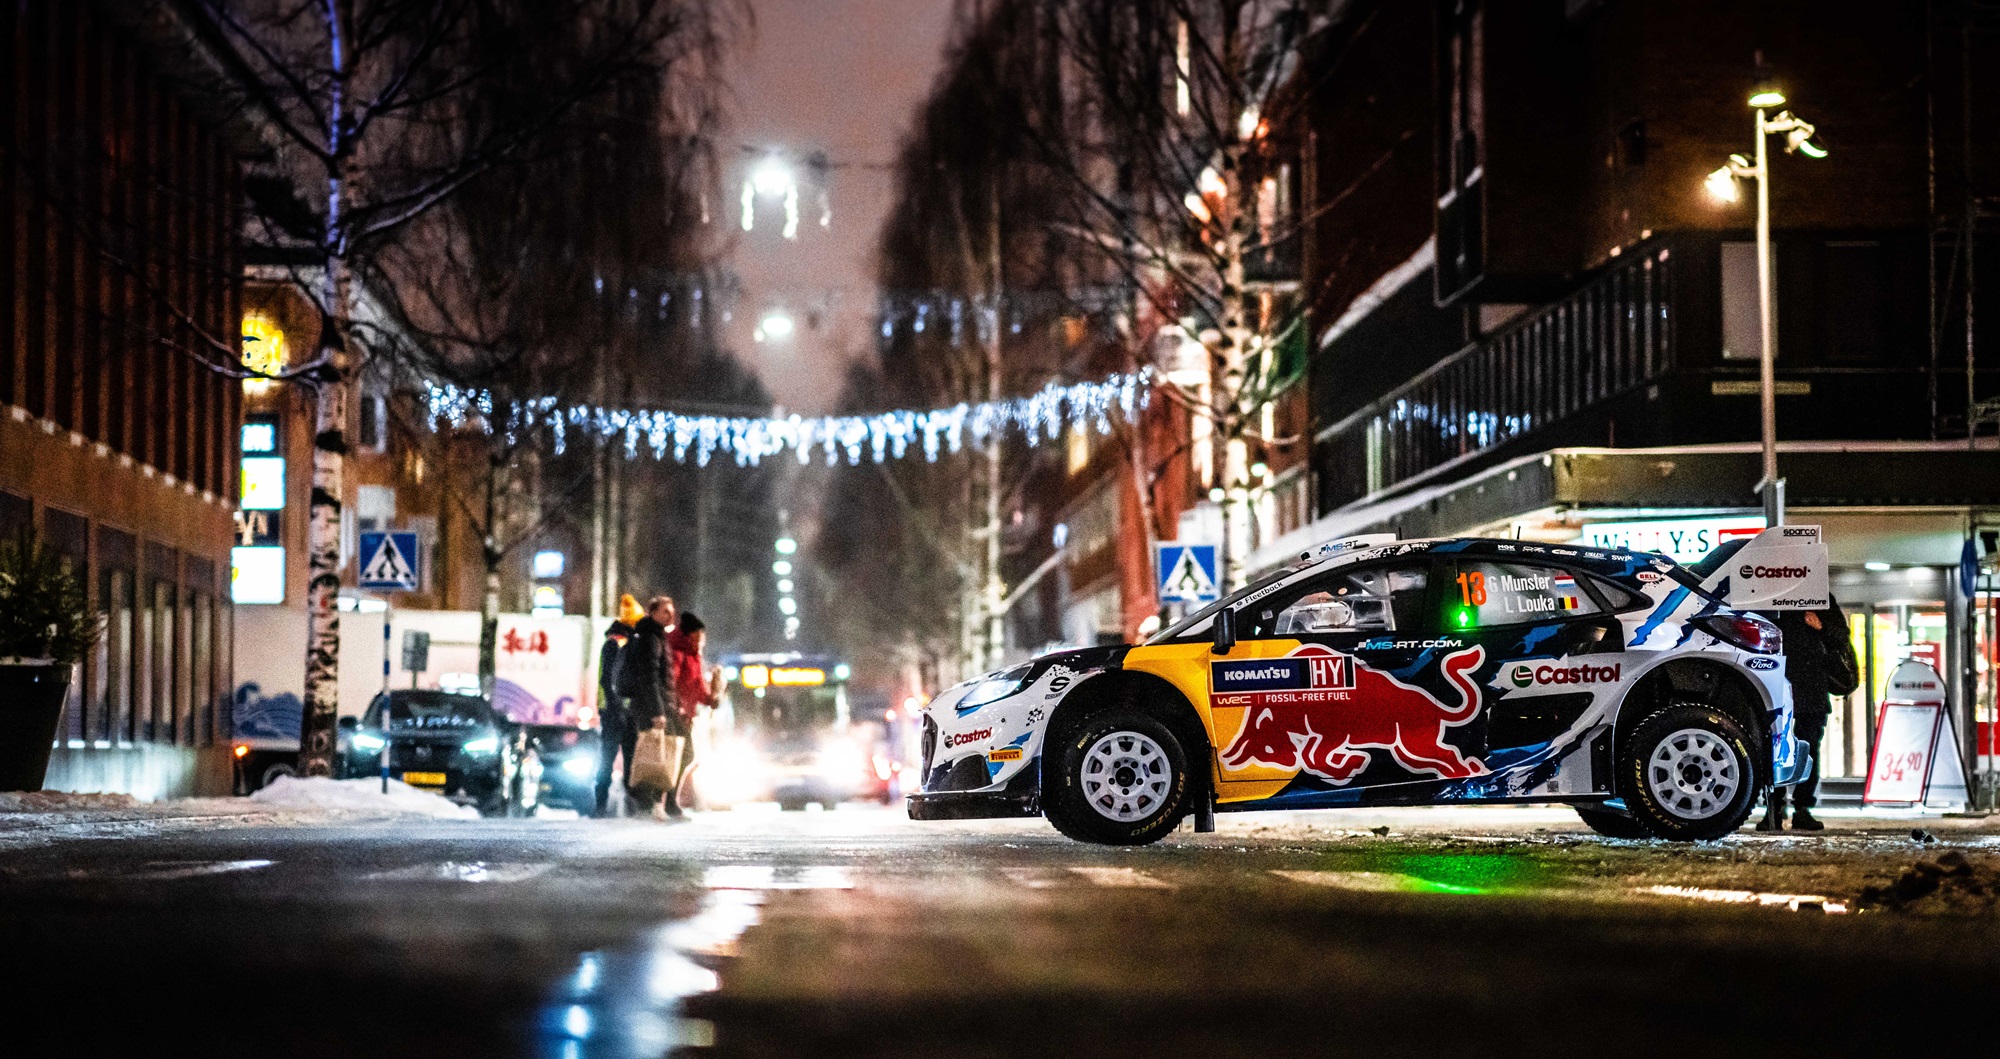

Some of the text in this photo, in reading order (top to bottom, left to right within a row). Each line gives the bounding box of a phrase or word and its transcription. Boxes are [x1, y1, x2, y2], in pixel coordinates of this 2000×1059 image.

[1755, 565, 1807, 578] Castrol
[1245, 582, 1284, 604] Fleetback
[1457, 571, 1487, 606] 13
[1488, 574, 1551, 593] G Munster
[1505, 594, 1555, 613] L Louka
[1772, 598, 1827, 607] SafetyCulture
[1366, 639, 1464, 650] MS-RT.COM
[1312, 659, 1342, 685] HY
[1751, 658, 1773, 669] Ford
[1224, 667, 1290, 681] KOMATSU
[1535, 663, 1621, 685] Castrol
[1217, 696, 1251, 705] WRC
[1265, 692, 1351, 703] FOSSIL-FREE FUEL
[954, 727, 992, 746] Castrol
[1881, 752, 1922, 781] 34 90
